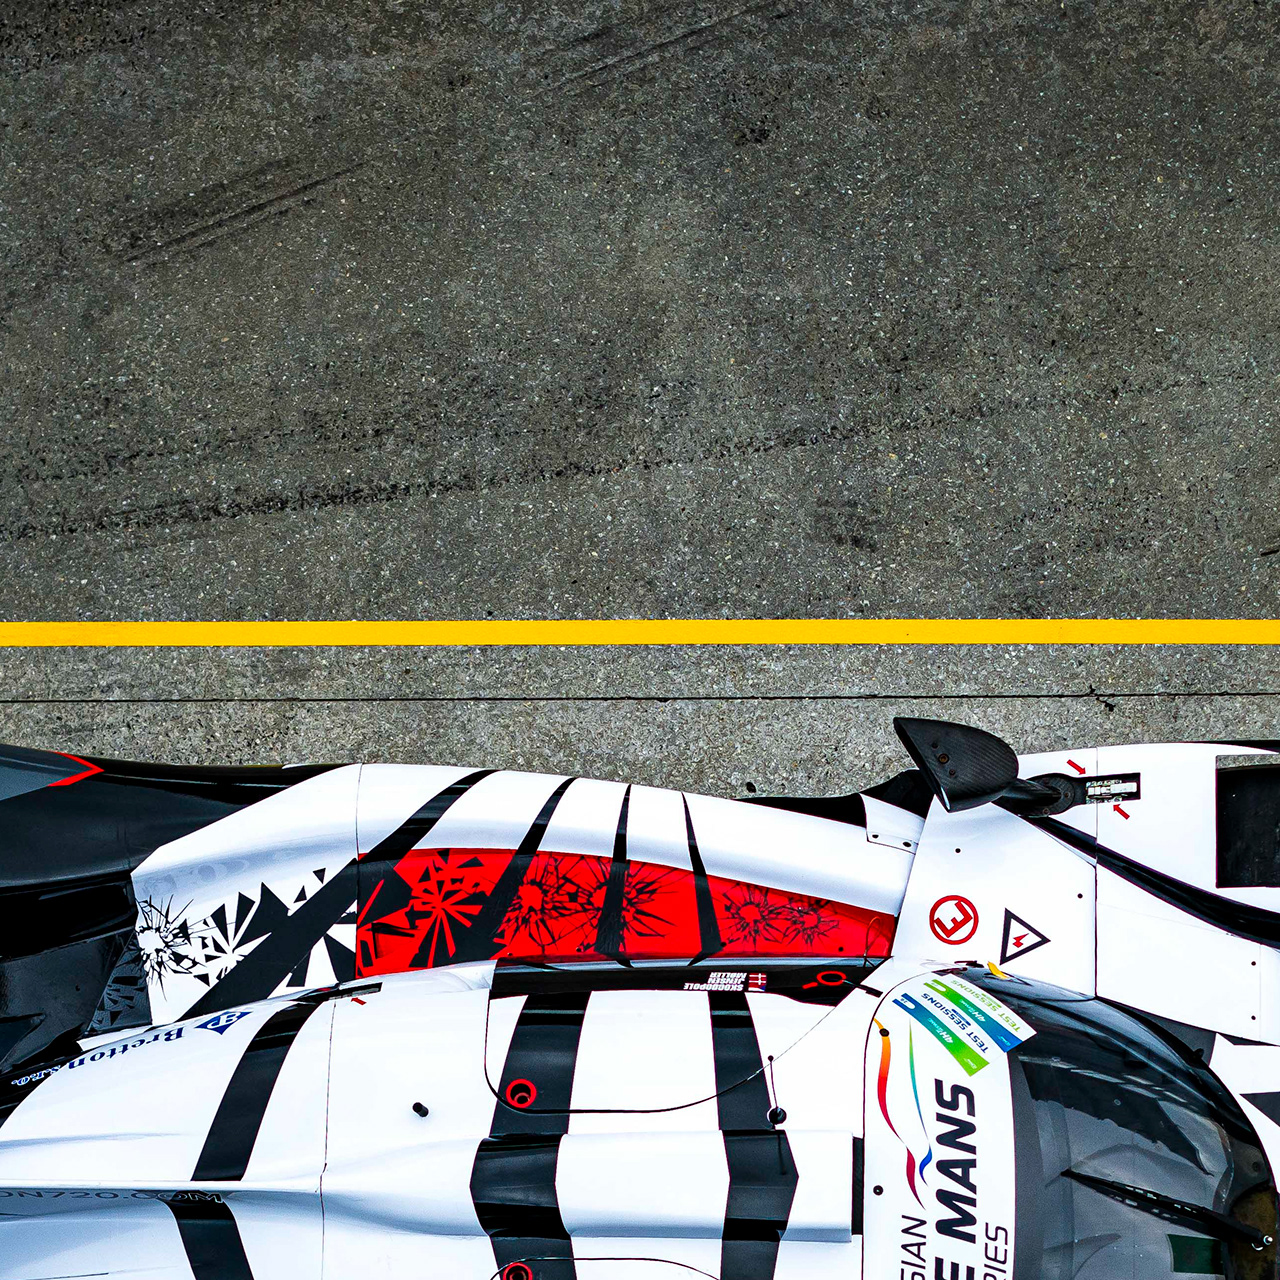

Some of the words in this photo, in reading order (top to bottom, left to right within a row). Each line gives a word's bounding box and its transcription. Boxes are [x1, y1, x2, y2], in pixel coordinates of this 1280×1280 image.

[921, 993, 968, 1031] SESSIONS
[951, 980, 999, 1012] SESSIONS
[998, 1013, 1021, 1033] TEST
[68, 1026, 185, 1070] Bretton
[966, 1031, 989, 1054] TEST
[11, 1065, 61, 1086] s.r.o.
[934, 1078, 977, 1244] MANS
